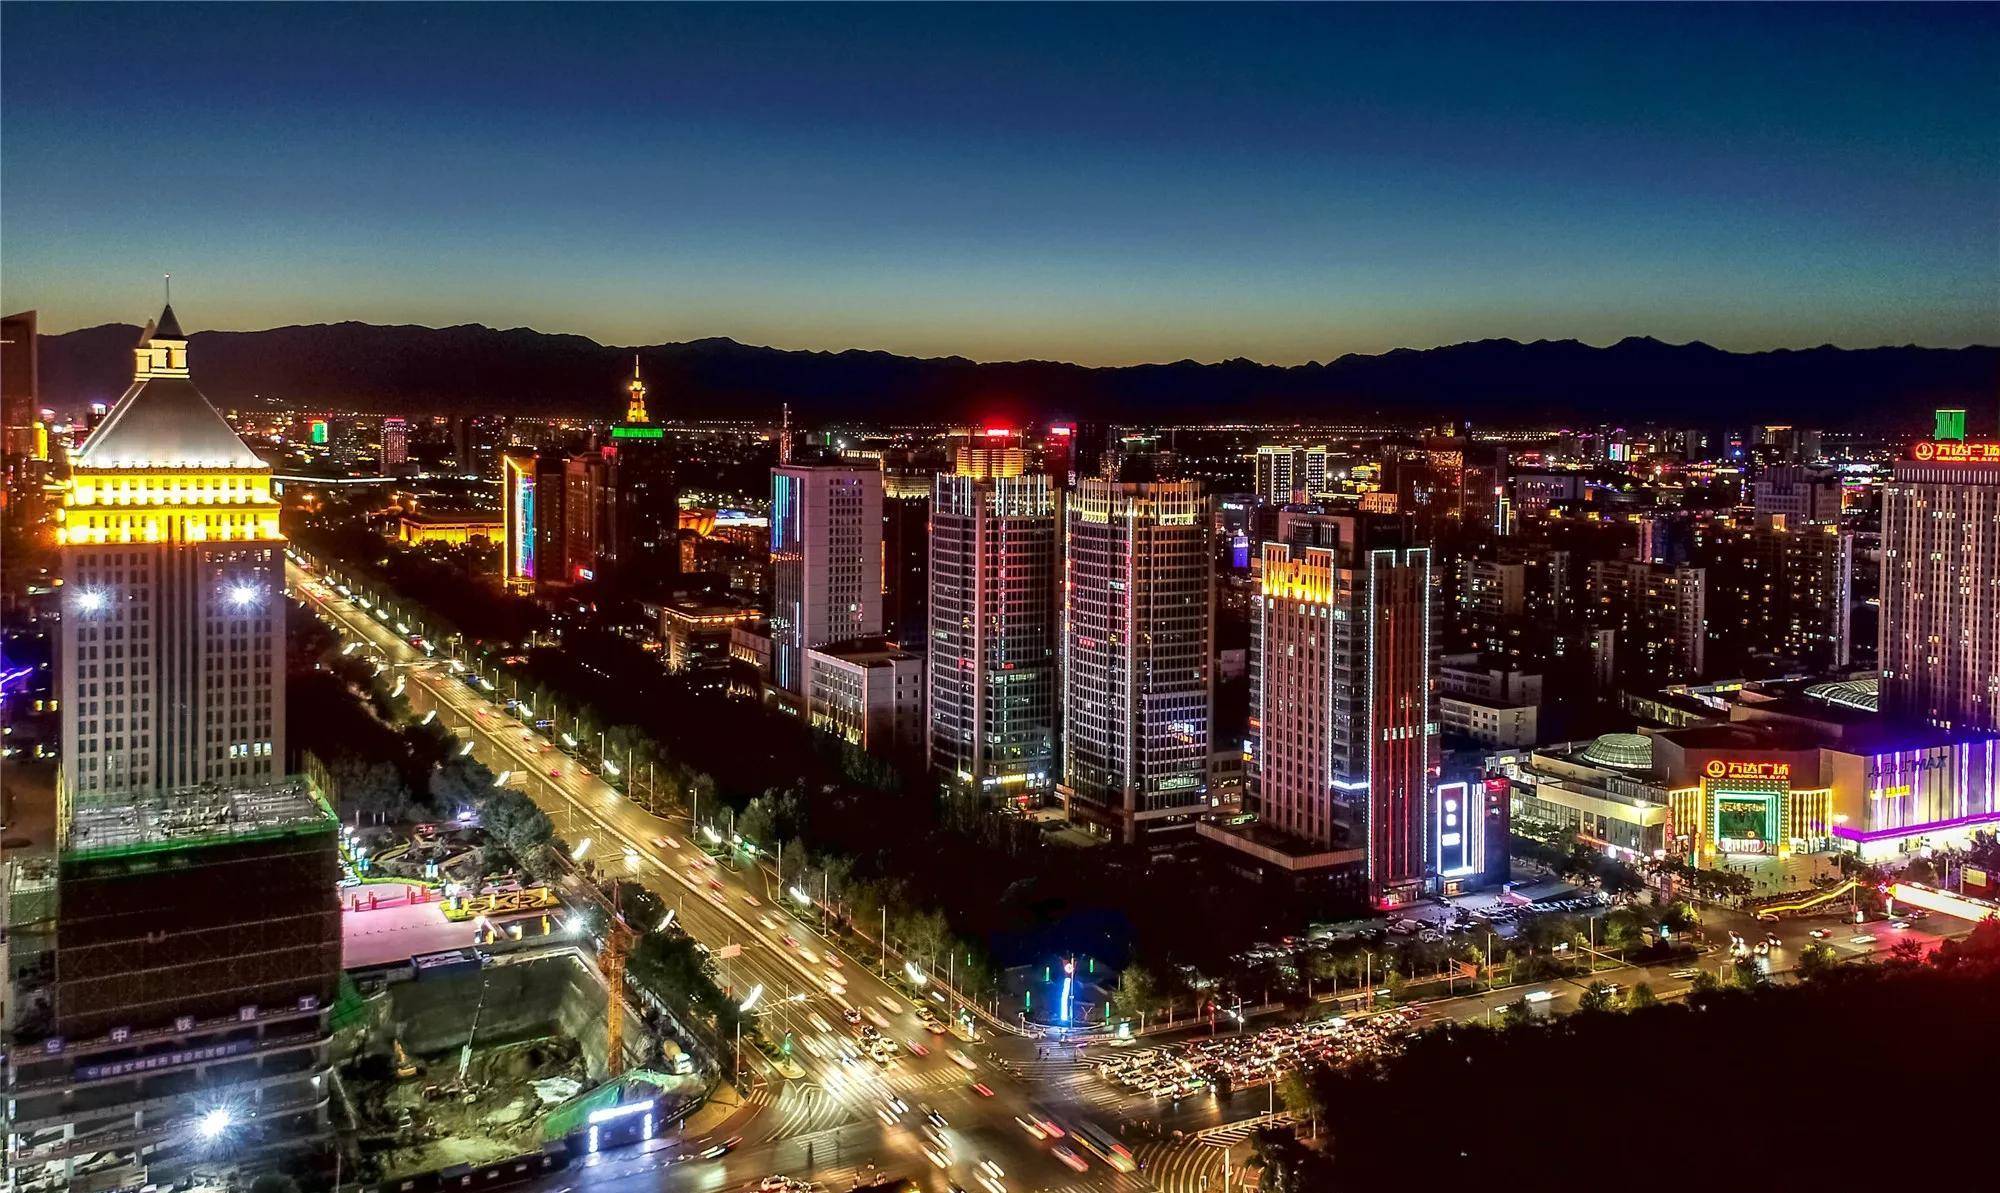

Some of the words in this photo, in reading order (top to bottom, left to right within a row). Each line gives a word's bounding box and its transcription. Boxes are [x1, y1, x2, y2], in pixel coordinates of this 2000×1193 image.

[1936, 443, 2000, 456] 万达广场
[1728, 762, 1789, 775] 万达广场
[112, 998, 315, 1042] 中铁建工
